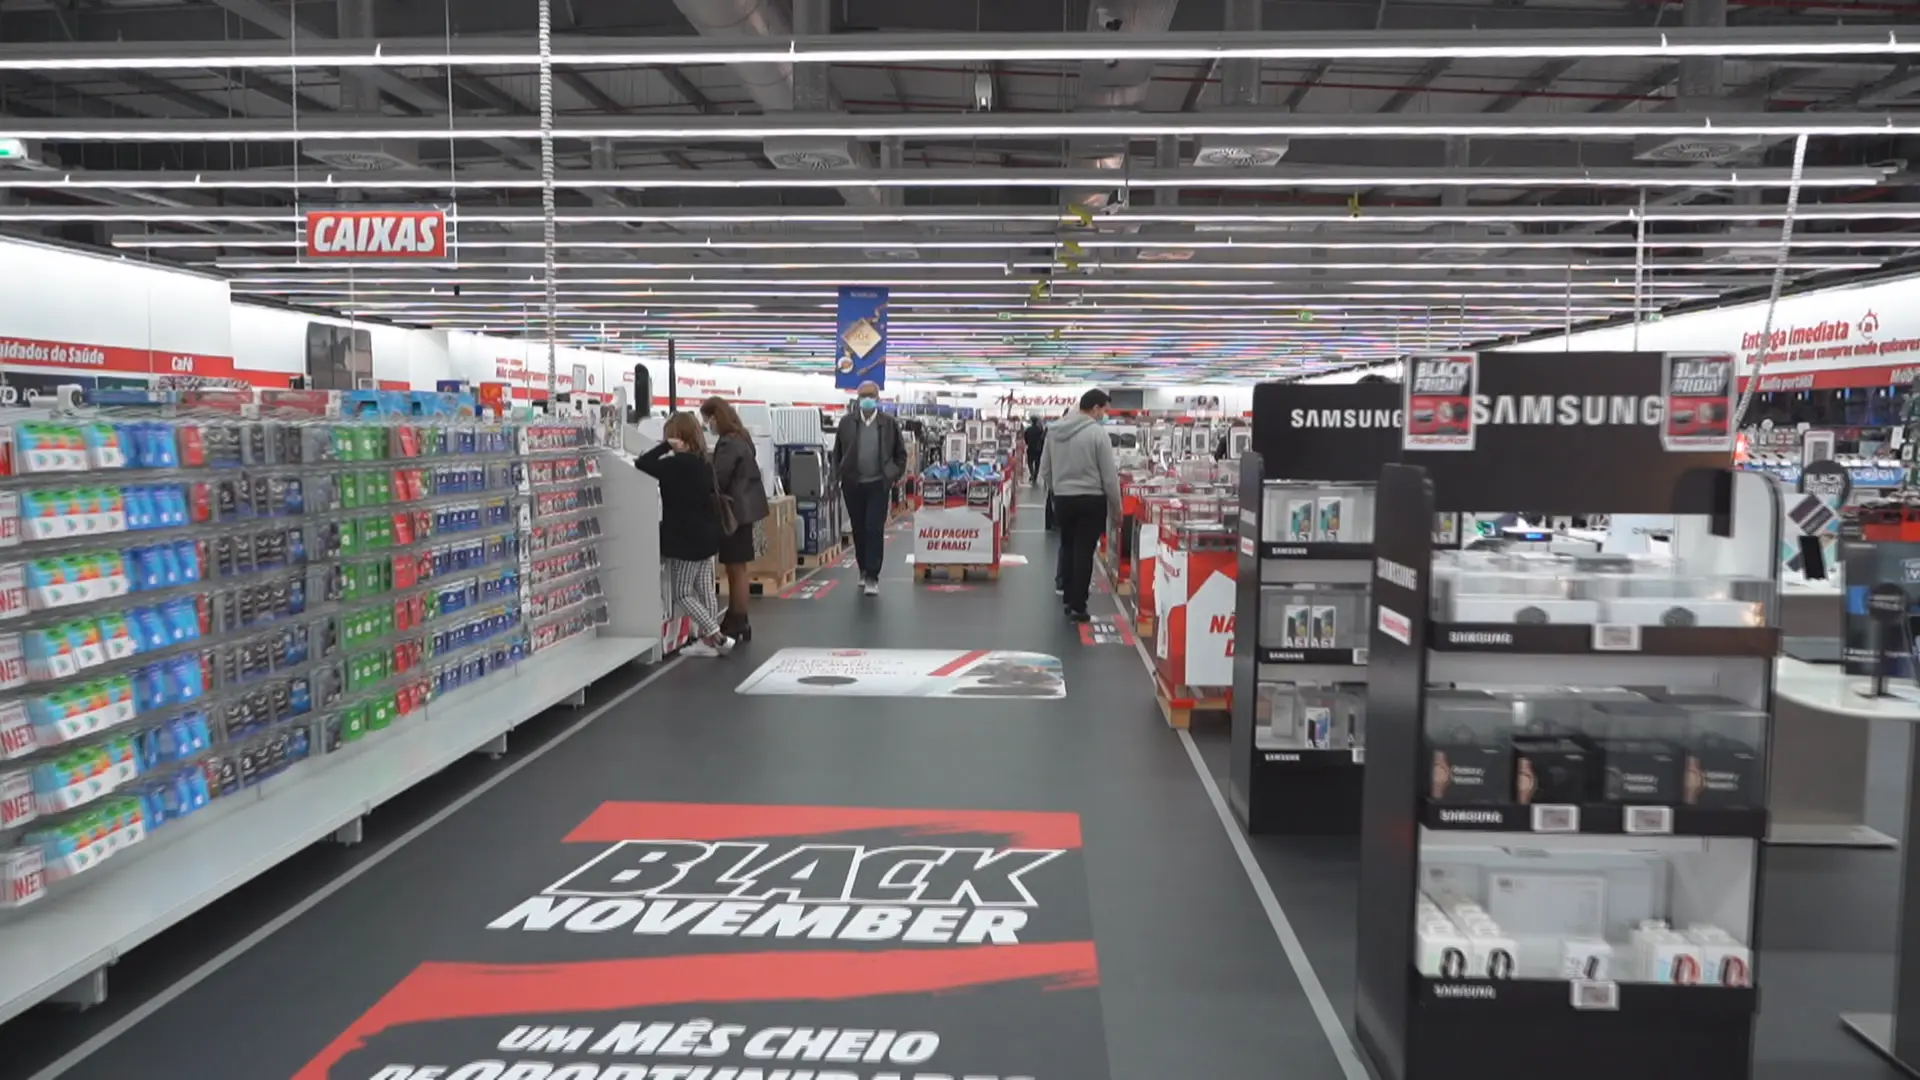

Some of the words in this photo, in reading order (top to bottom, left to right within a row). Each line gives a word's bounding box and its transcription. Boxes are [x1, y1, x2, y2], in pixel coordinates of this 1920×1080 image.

[313, 215, 438, 254] CAIXAS
[1742, 329, 1787, 352] Entega
[51, 346, 67, 362] de
[68, 347, 105, 365] Saúde
[171, 356, 194, 373] Café
[1472, 395, 1663, 425] SAMSUNG
[919, 526, 940, 539] NÃO
[942, 528, 980, 539] PAGUES
[927, 541, 939, 551] DE
[1209, 612, 1237, 634] NÃ
[540, 839, 1066, 908] BLACK
[485, 896, 1028, 944] NOVEMBER
[496, 1024, 595, 1053] UM
[587, 1018, 747, 1058] MÊS
[743, 1026, 940, 1065] CHEIO
